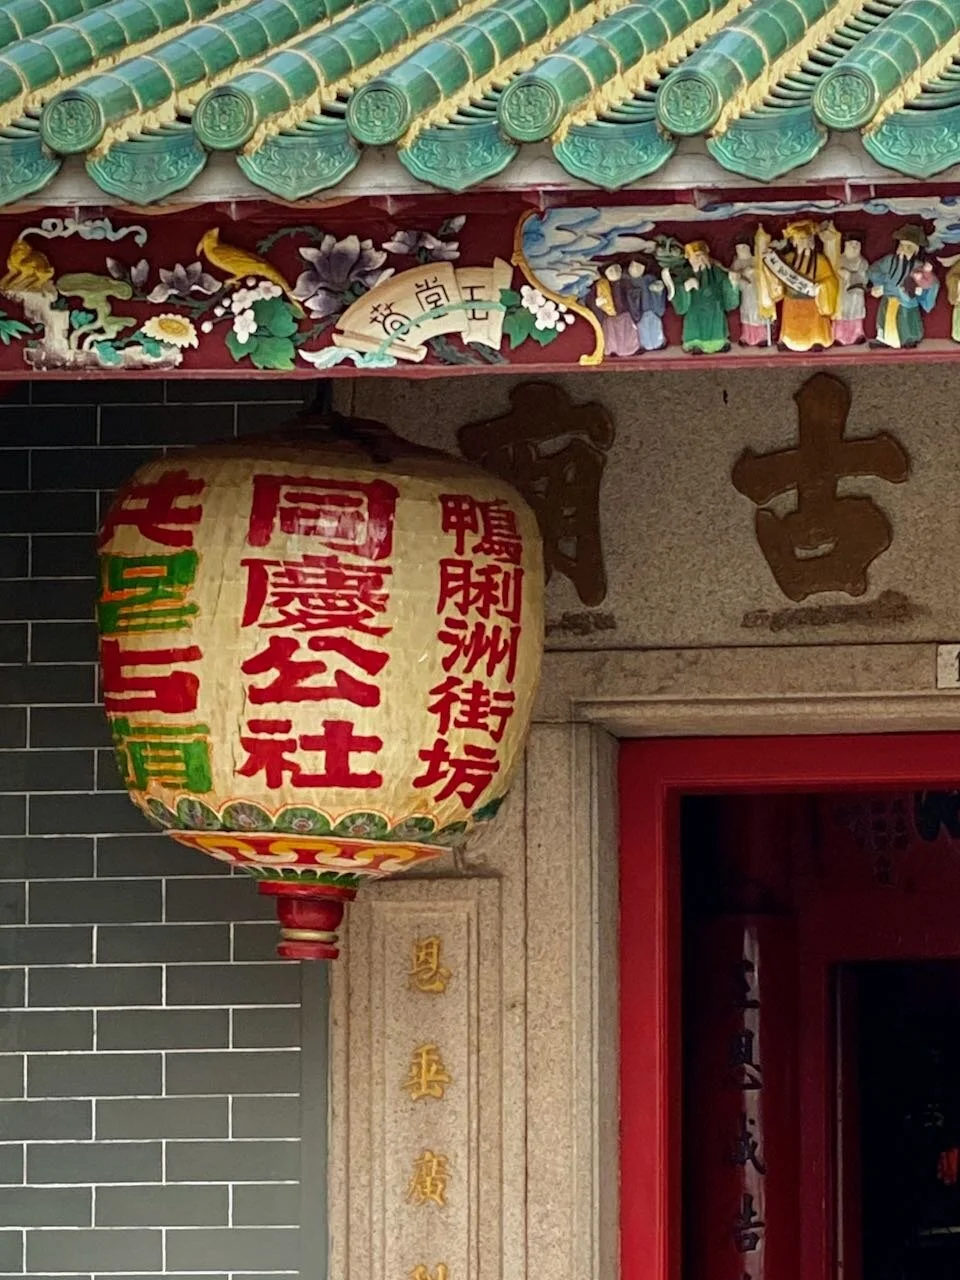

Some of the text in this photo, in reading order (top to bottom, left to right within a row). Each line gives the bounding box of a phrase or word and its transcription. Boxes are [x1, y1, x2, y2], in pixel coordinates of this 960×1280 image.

[234, 473, 399, 791] 同慶公社
[412, 492, 524, 811] 鴨脷洲街坊
